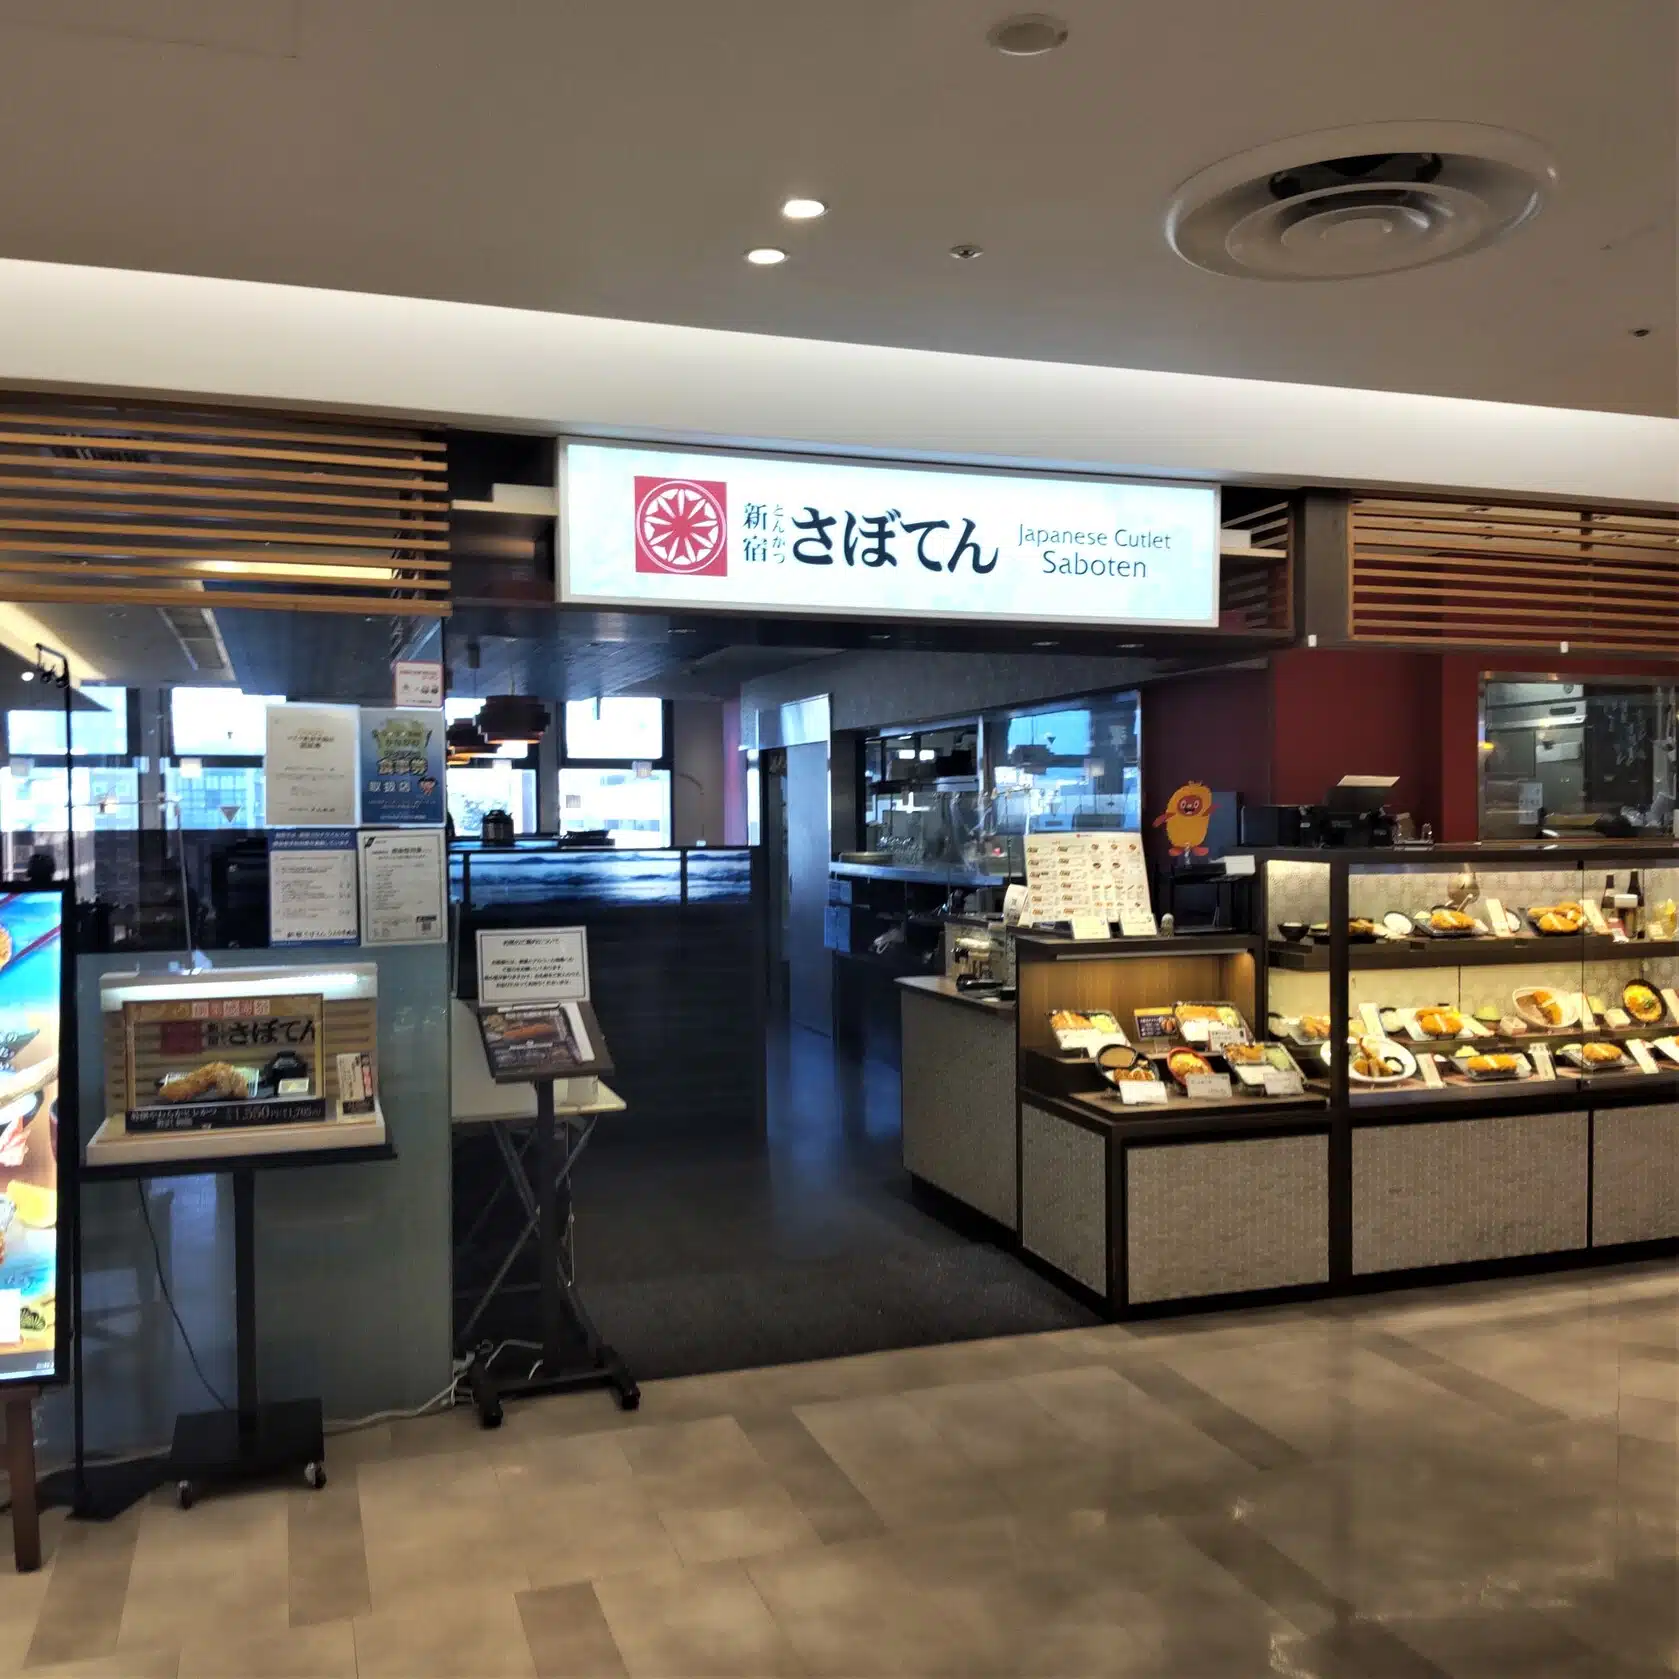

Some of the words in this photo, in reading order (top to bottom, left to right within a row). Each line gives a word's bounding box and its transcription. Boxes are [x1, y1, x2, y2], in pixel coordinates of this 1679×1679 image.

[742, 502, 768, 563] 新宿
[772, 503, 786, 565] とんかつ
[791, 506, 999, 575] さぼてん
[1018, 523, 1108, 548] Japanese
[1114, 528, 1172, 550] Cutlet
[1042, 550, 1147, 578] Saboten
